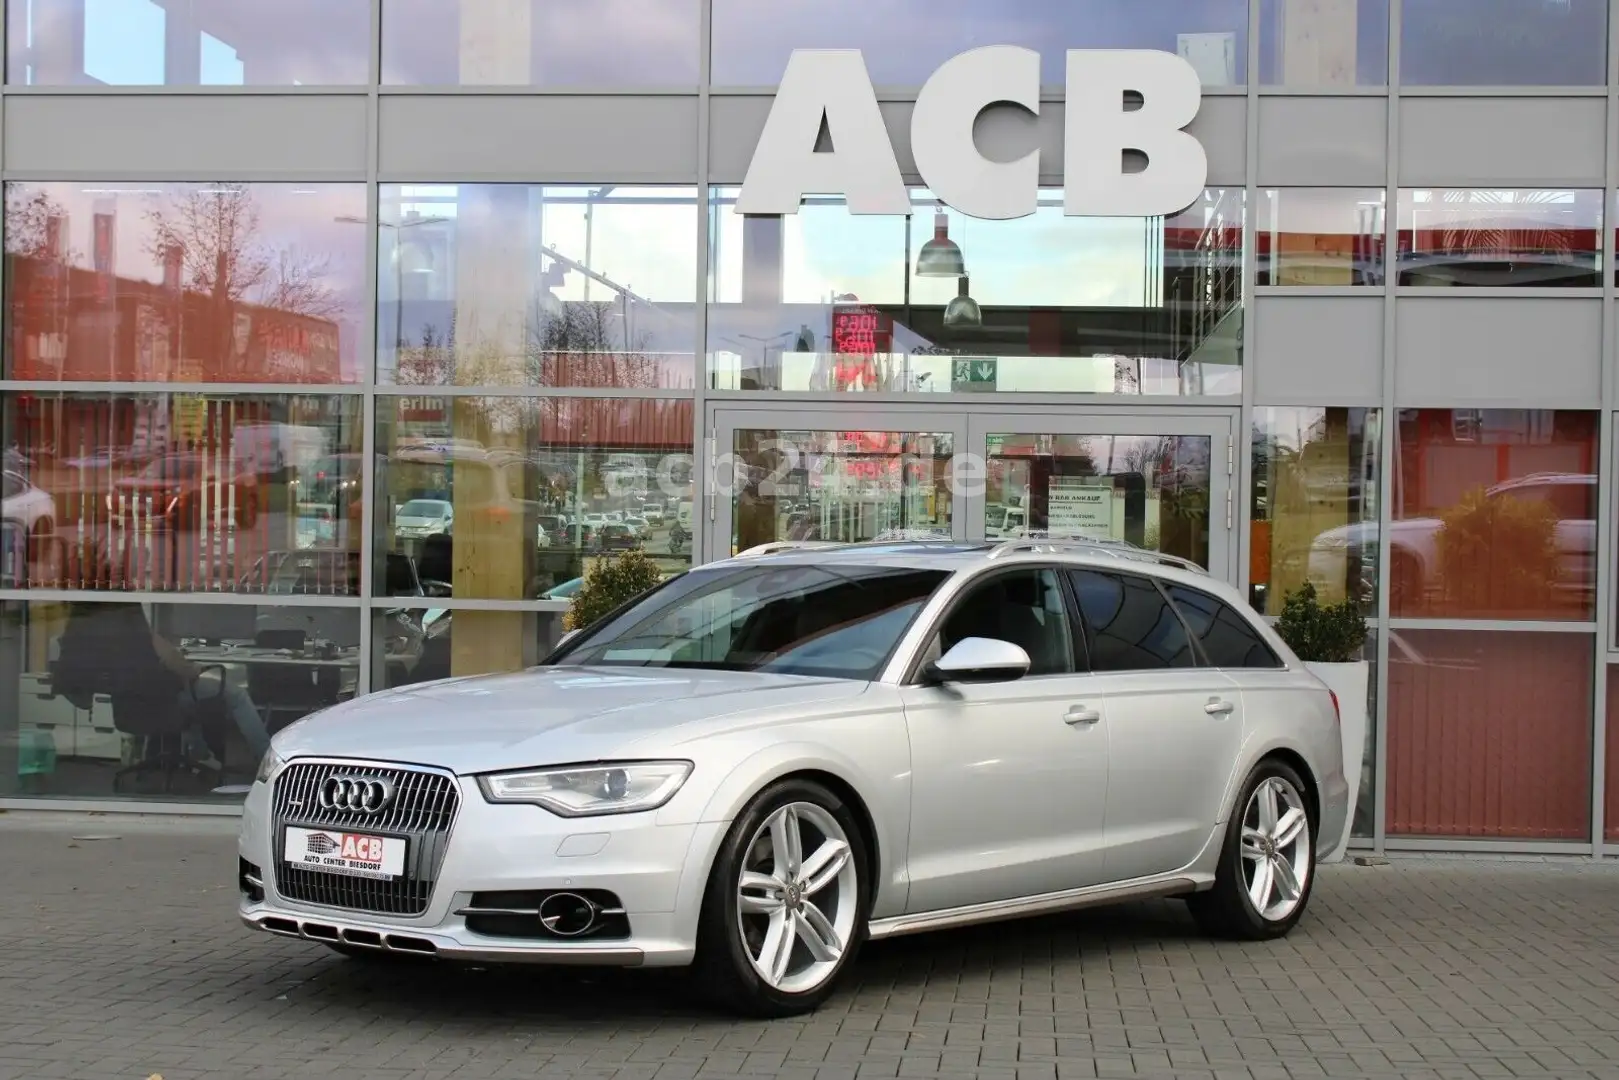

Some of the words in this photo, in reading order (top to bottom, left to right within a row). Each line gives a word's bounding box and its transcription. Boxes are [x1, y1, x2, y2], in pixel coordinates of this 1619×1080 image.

[733, 44, 1208, 220] ACB
[341, 836, 382, 861] ACB
[304, 855, 320, 864] AUTO
[323, 857, 346, 867] CENTER
[349, 861, 381, 871] BIESDORF
